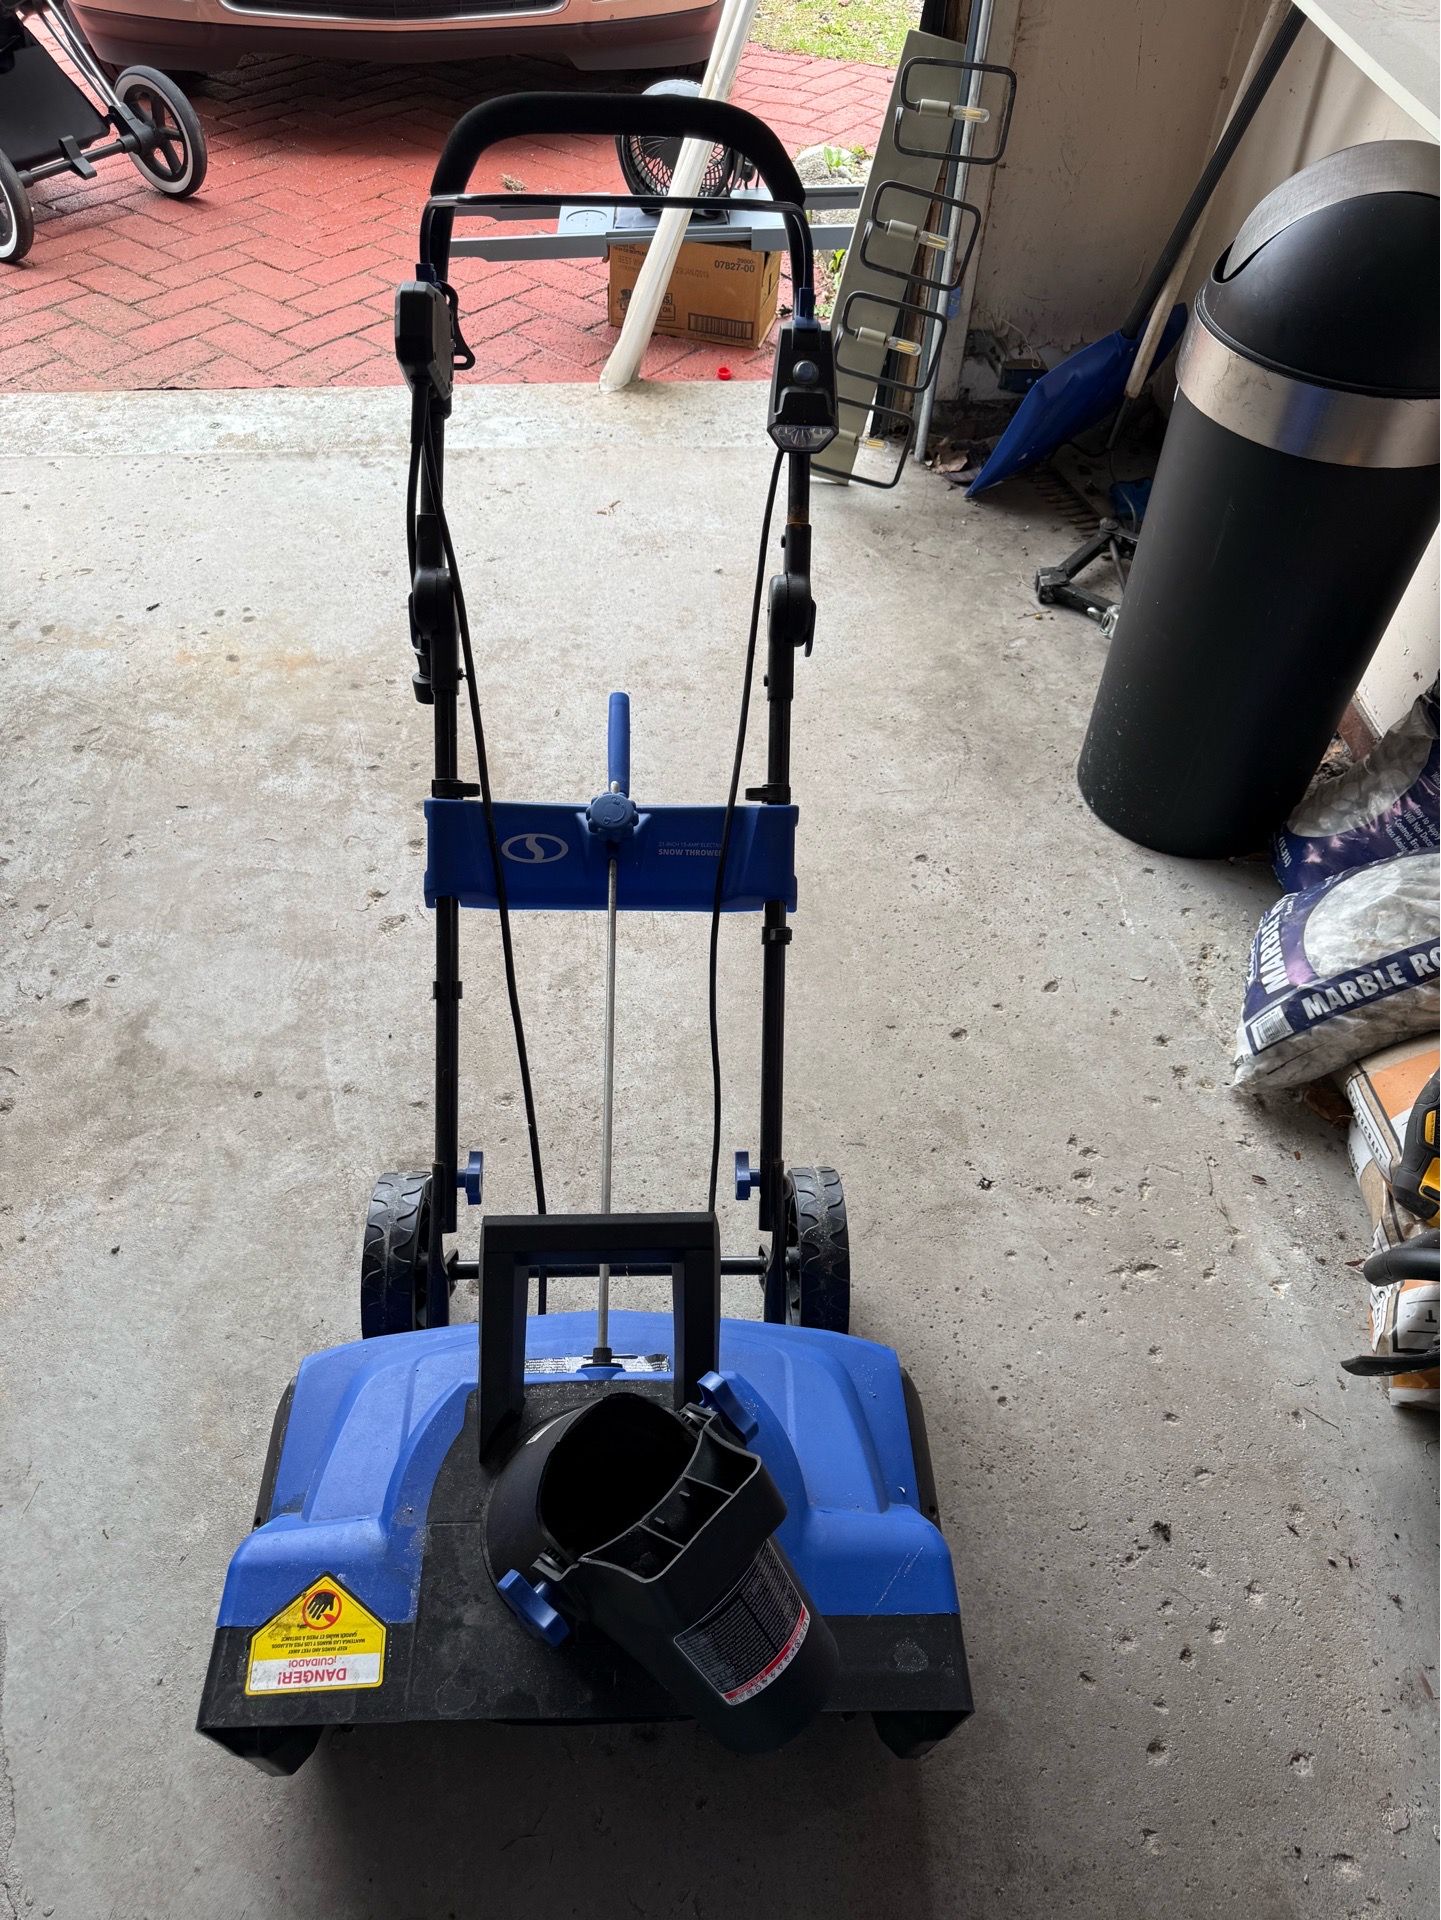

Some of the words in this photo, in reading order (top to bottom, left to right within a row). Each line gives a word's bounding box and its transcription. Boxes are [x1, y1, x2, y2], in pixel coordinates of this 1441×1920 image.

[714, 260, 755, 272] 07827-00
[1412, 822, 1423, 833] Not
[658, 848, 684, 856] SNOW
[1260, 914, 1290, 995] MARBLE
[1301, 962, 1408, 1020] MARBLE
[288, 1656, 336, 1668] ¡CUIDADO!
[277, 1668, 347, 1685] DANGER!
